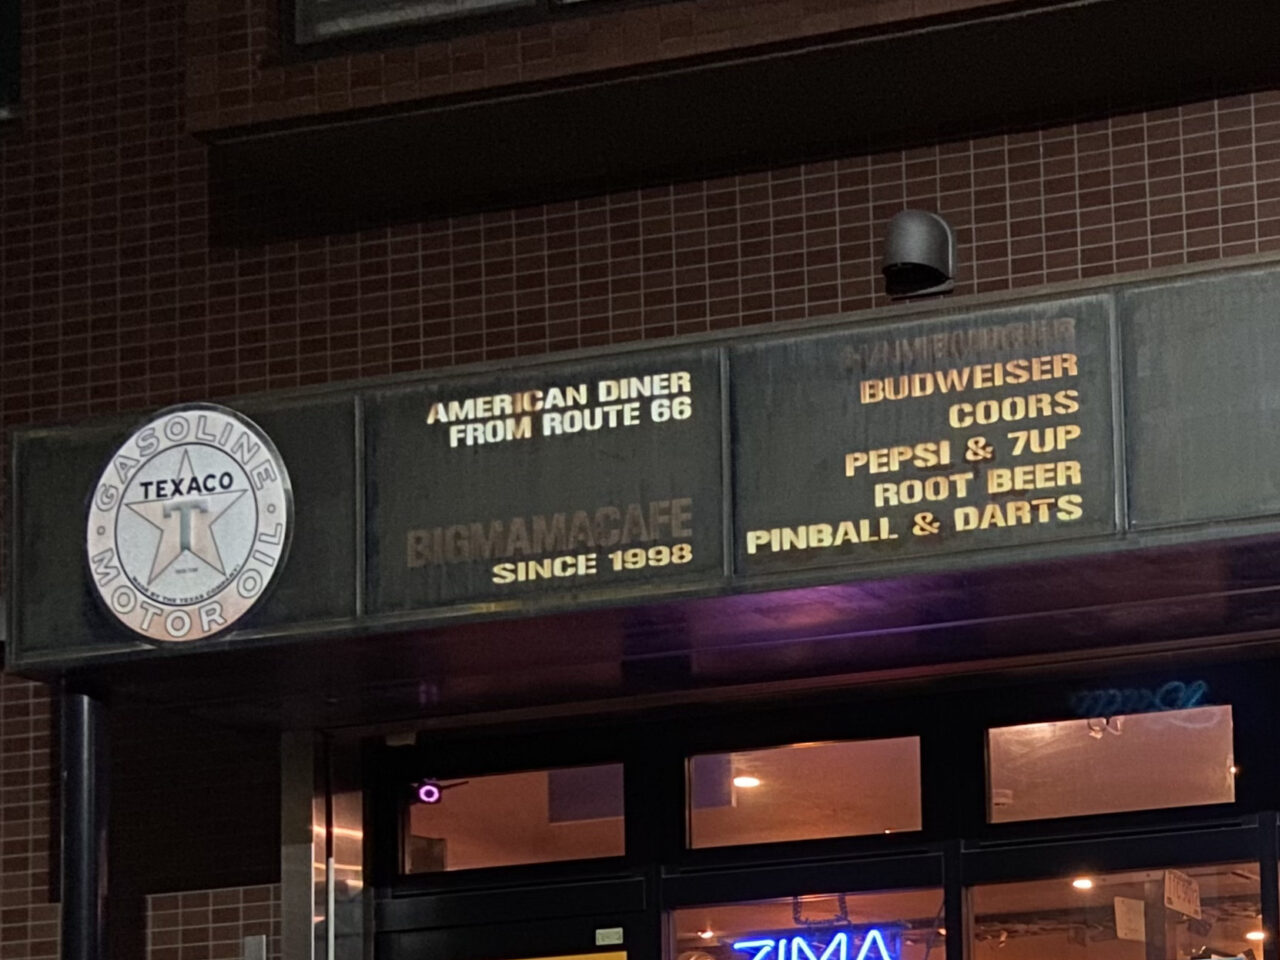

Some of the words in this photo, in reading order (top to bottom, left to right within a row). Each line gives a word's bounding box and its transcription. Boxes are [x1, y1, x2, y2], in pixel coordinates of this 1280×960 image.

[427, 384, 587, 424] AMERICAN
[598, 371, 691, 402] DINER
[860, 353, 1078, 404] BUDWEISER
[450, 415, 532, 447] FROM
[542, 402, 640, 436] ROUTE
[650, 396, 692, 422] 66
[949, 390, 1079, 428] COORS
[95, 415, 277, 513] GASOLINE
[845, 440, 951, 477] PEPSI
[965, 436, 994, 462] &
[1007, 425, 1082, 456] 7UP
[140, 472, 234, 500] TEXACO
[874, 472, 975, 508] ROOT
[987, 461, 1083, 494] BEER
[163, 498, 209, 553] T
[746, 517, 898, 554] PINBALL
[912, 512, 941, 536] &
[954, 494, 1084, 532] DARTS
[237, 522, 284, 600] OIL
[492, 553, 598, 584] SINCE
[608, 543, 693, 572] 1998
[92, 548, 227, 639] MOTOR
